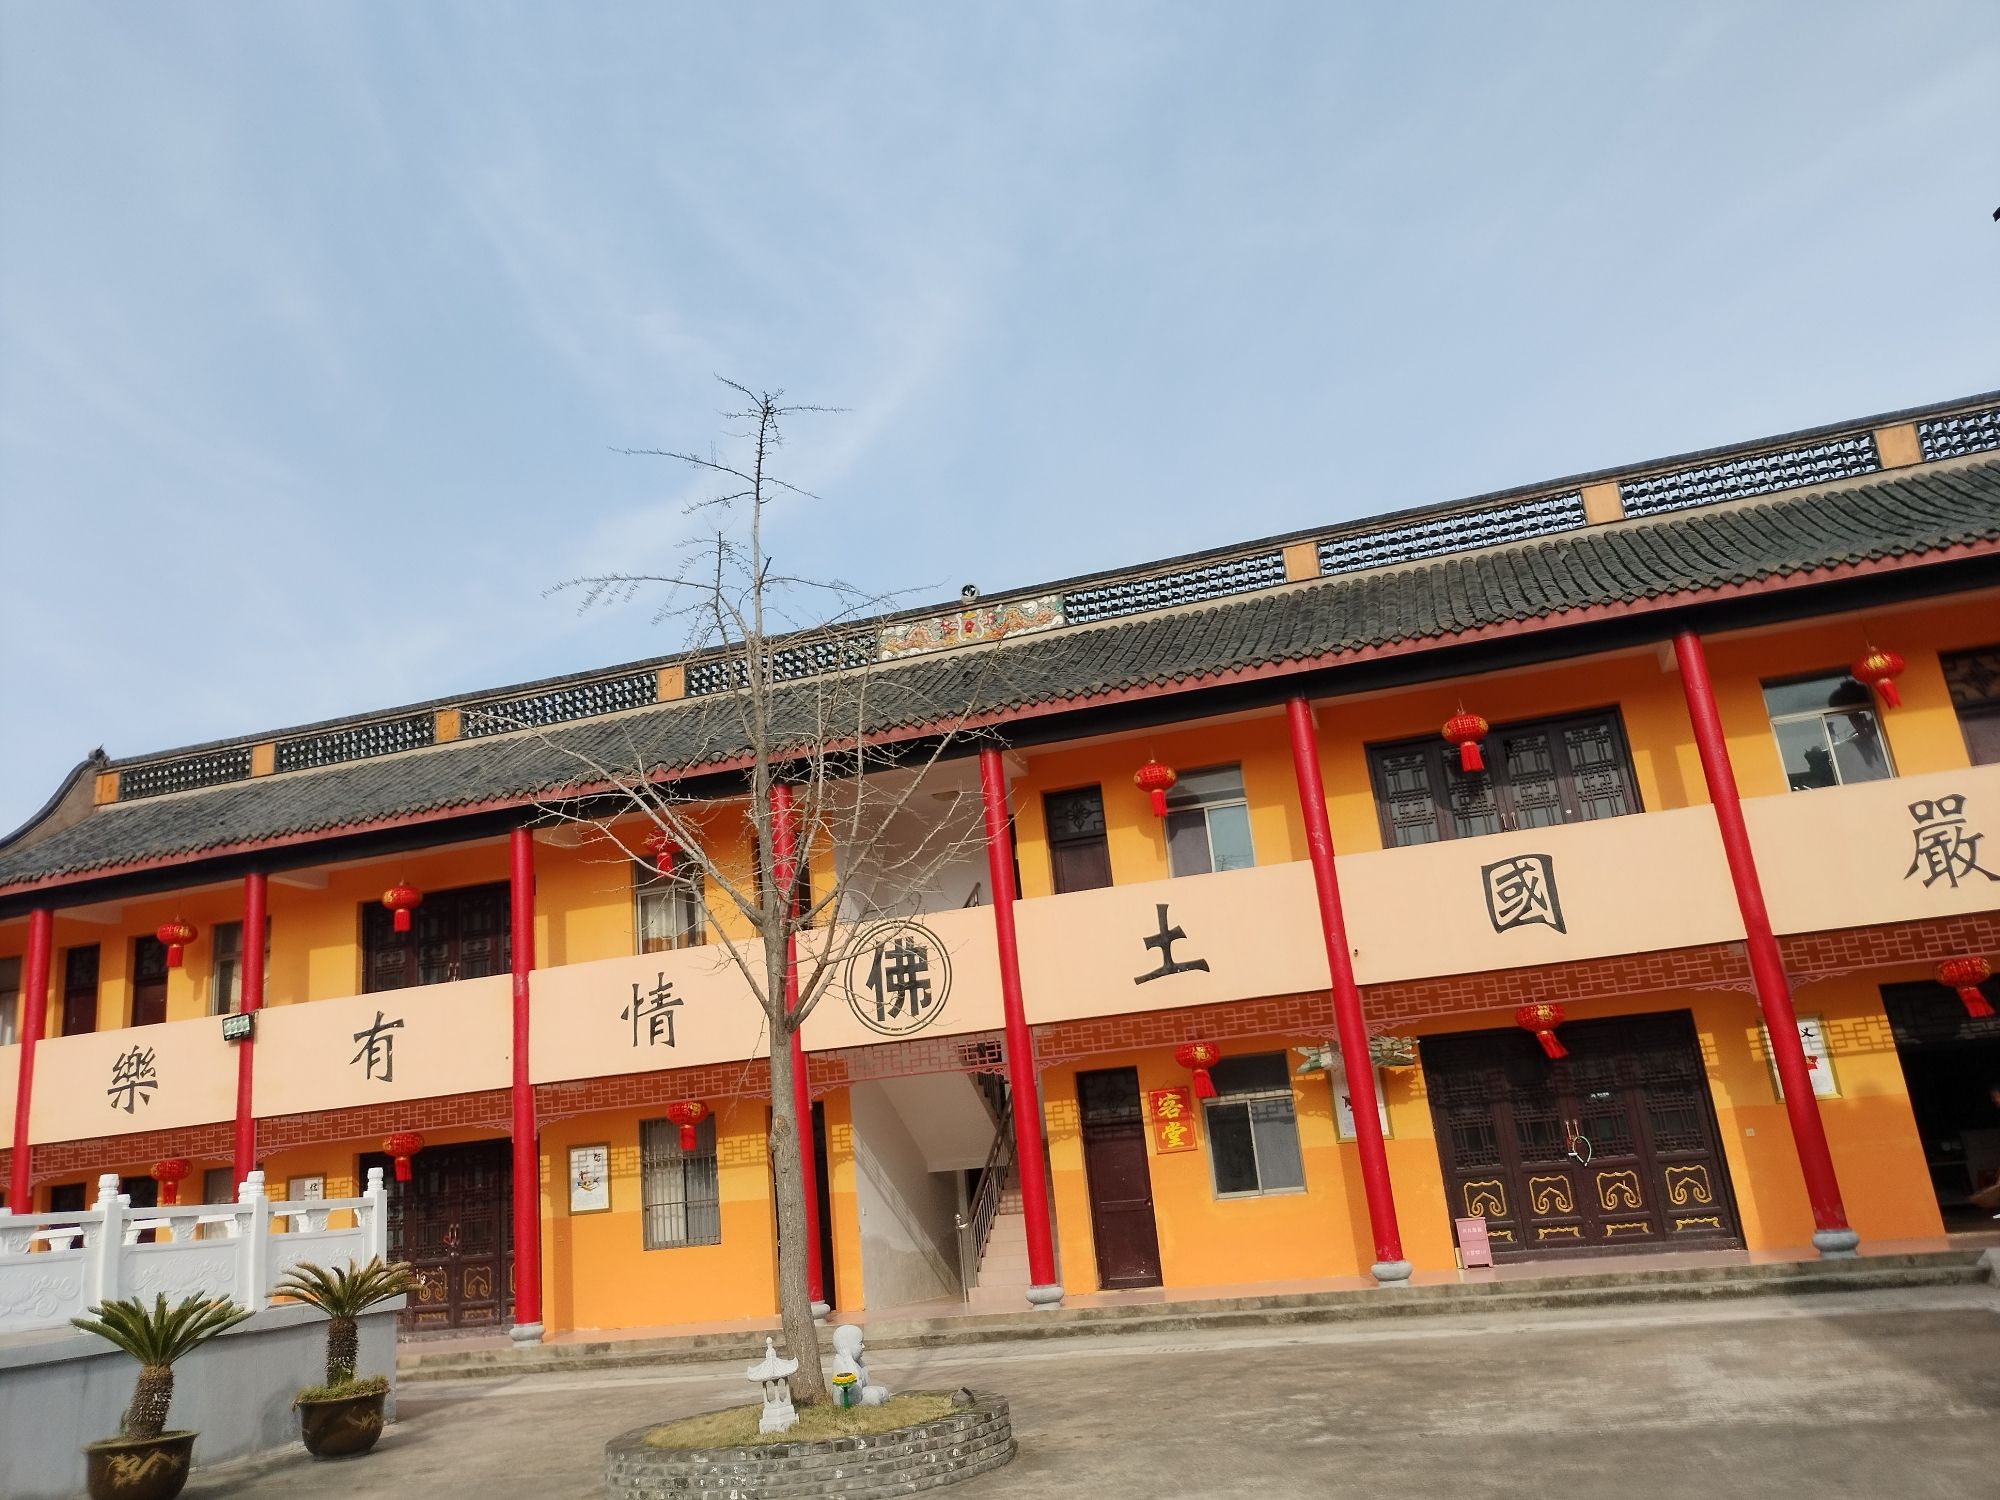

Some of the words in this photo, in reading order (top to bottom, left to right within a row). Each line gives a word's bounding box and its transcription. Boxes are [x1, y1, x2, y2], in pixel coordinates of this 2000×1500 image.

[1903, 793, 2000, 889] 嚴
[1480, 853, 1567, 935] 國
[865, 936, 932, 1022] 佛
[1133, 903, 1211, 986] 土
[107, 1044, 159, 1114] 樂
[349, 1010, 405, 1083] 有
[620, 971, 684, 1048] 情
[1157, 1092, 1188, 1148] 客堂
